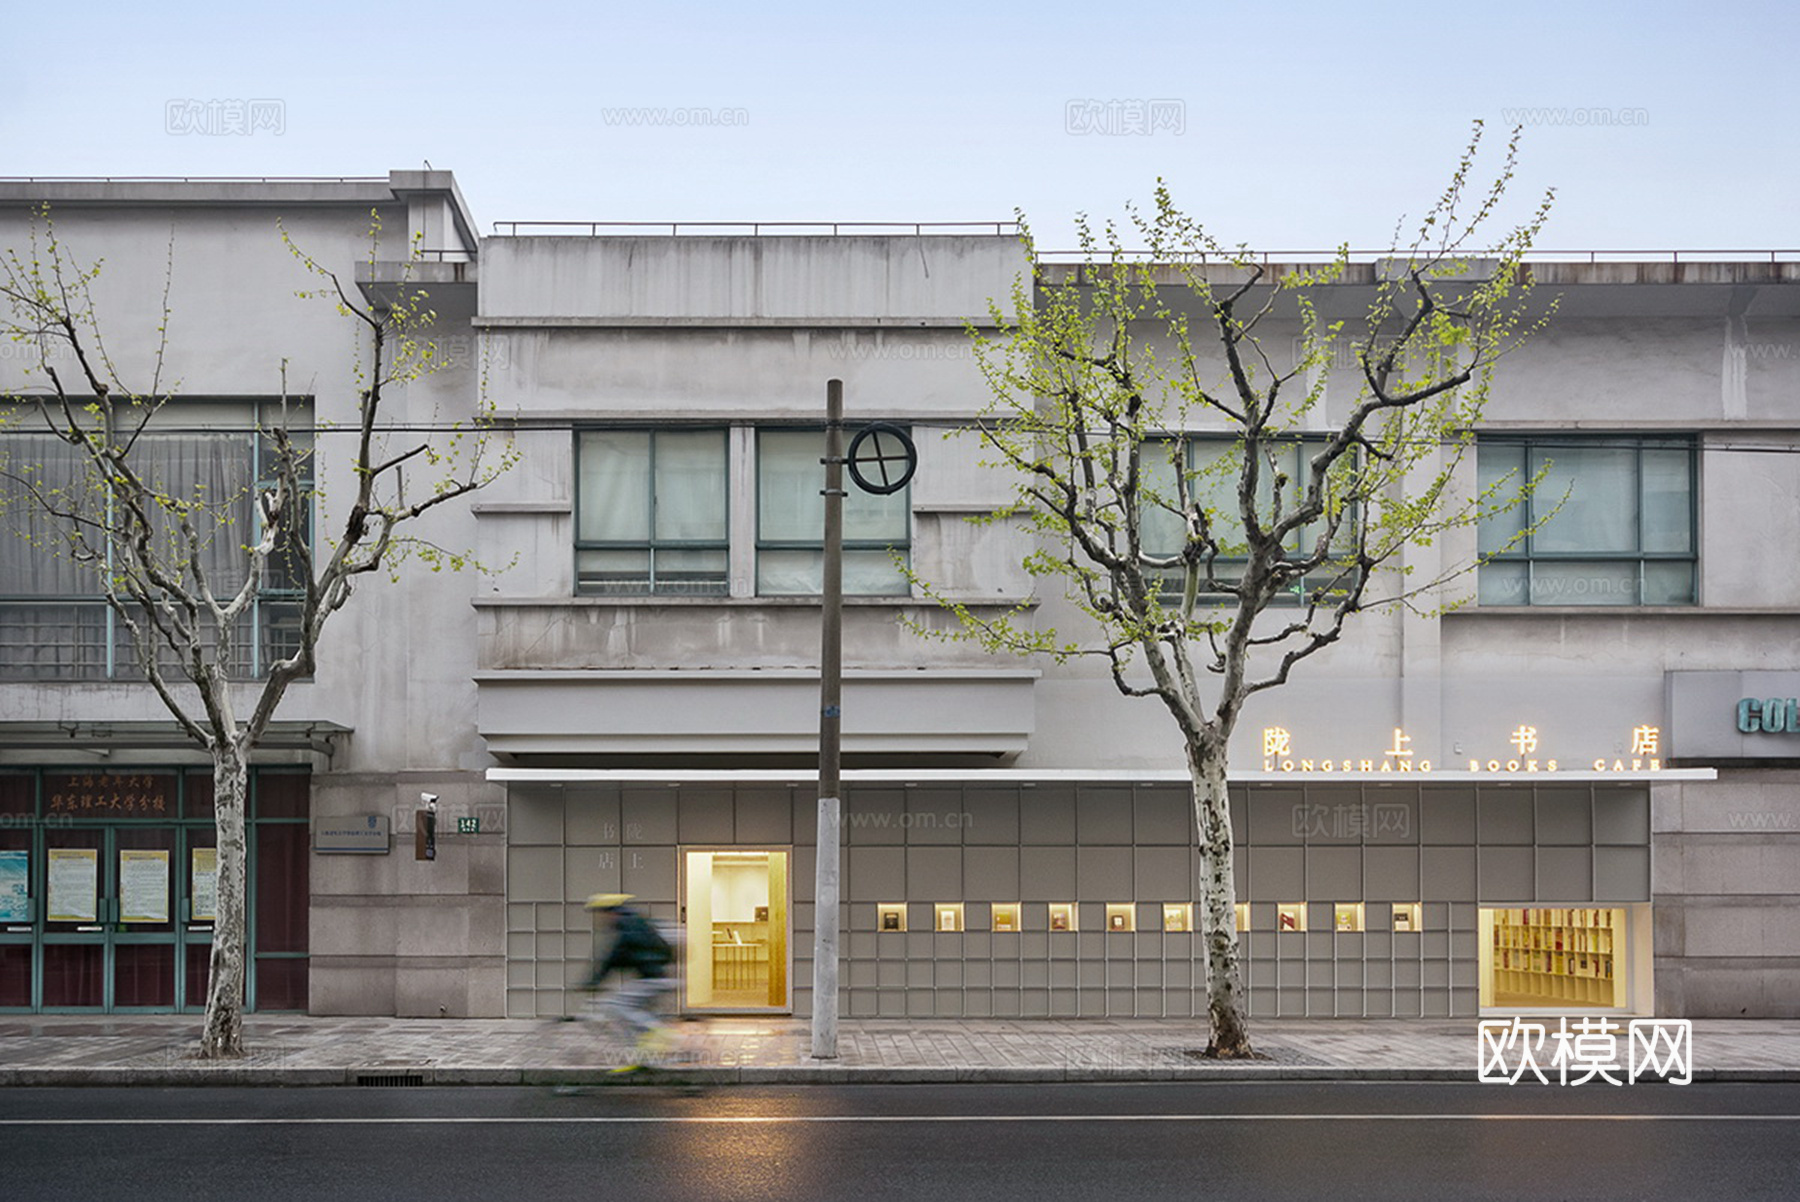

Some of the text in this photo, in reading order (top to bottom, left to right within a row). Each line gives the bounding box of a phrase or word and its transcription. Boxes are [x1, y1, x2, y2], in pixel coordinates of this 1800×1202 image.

[1264, 759, 1660, 772] LONGSHANG BOOKS CAFE
[51, 793, 166, 812] 华东理工大学分校
[460, 819, 476, 828] 142
